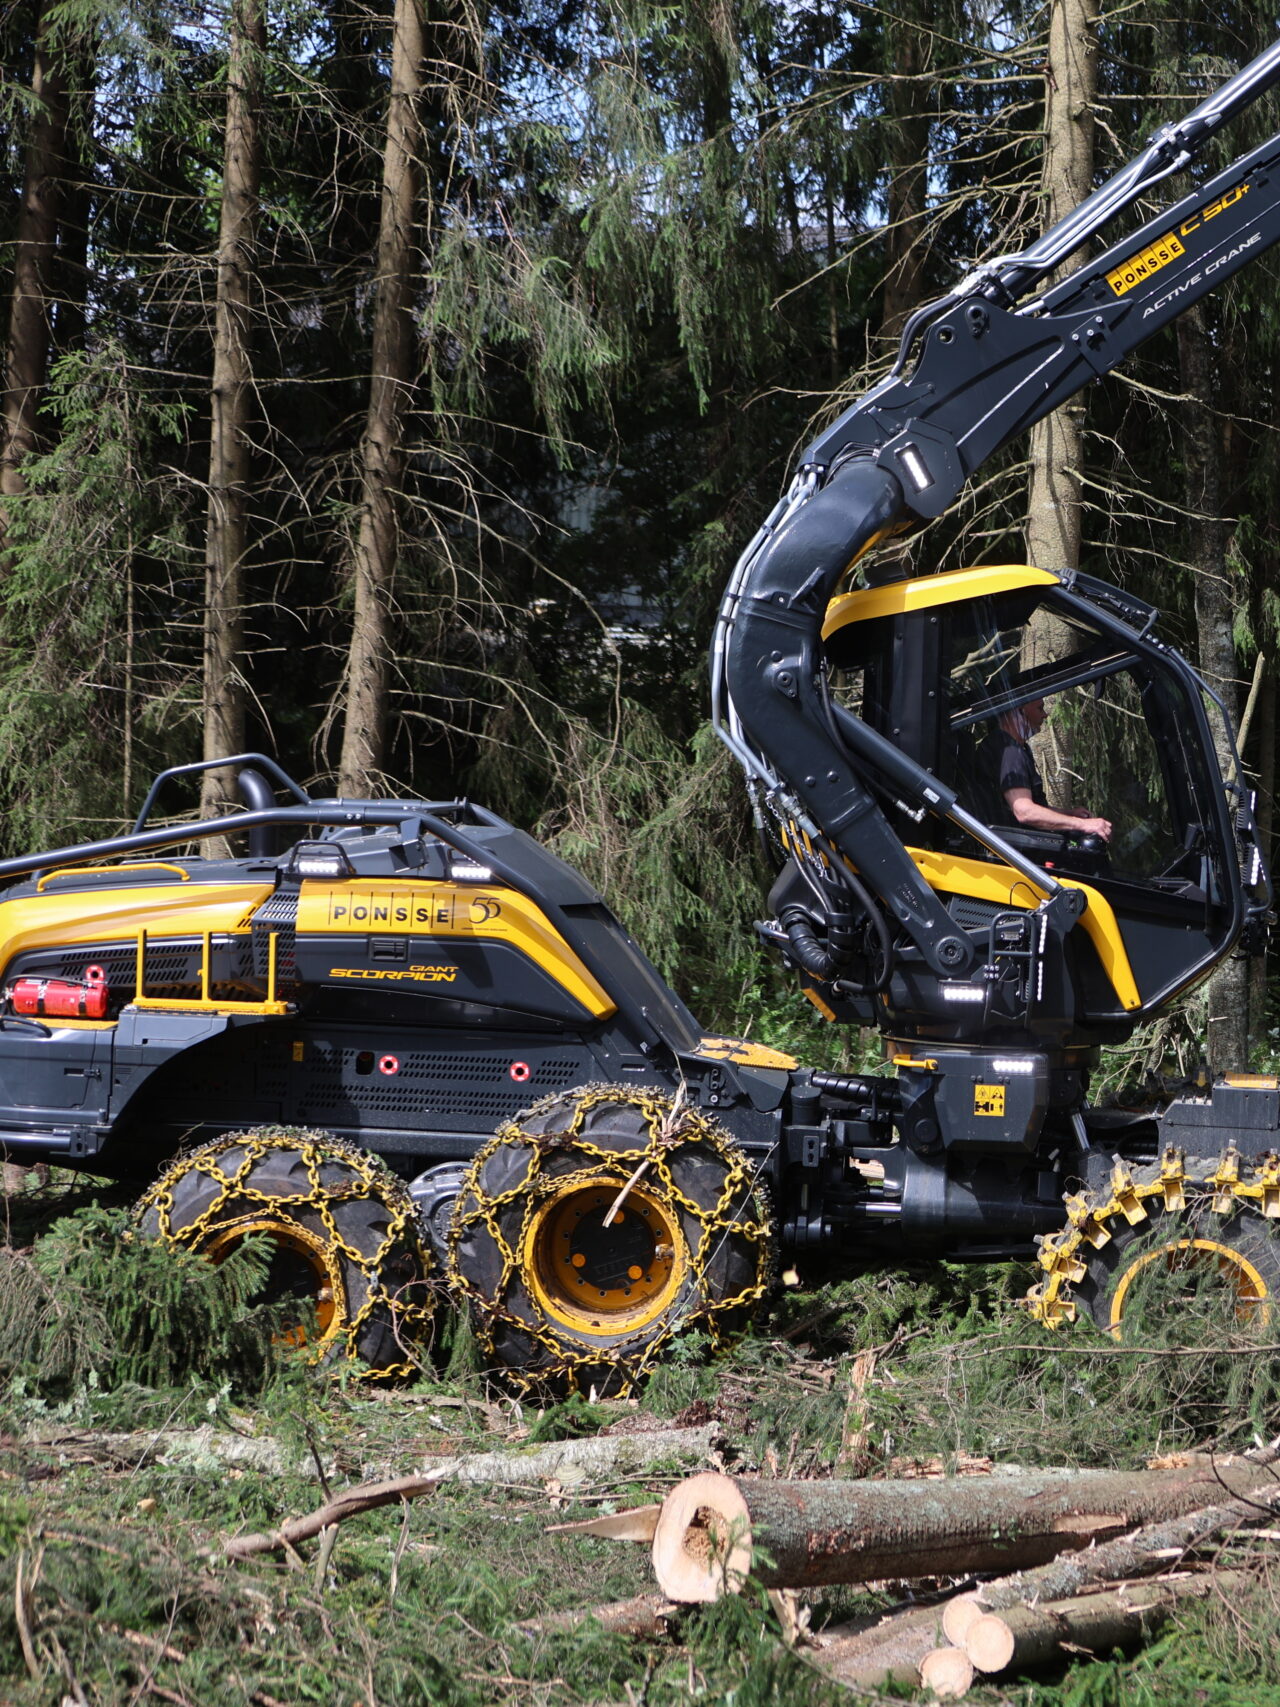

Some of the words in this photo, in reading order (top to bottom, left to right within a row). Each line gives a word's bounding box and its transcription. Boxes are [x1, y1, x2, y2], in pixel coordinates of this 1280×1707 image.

[1113, 242, 1181, 292] PONSSE
[1142, 272, 1202, 319] ACTIVE
[1205, 231, 1262, 276] CRANE
[334, 906, 449, 923] PONSSE
[469, 897, 501, 924] 55
[329, 968, 456, 982] SCORPION
